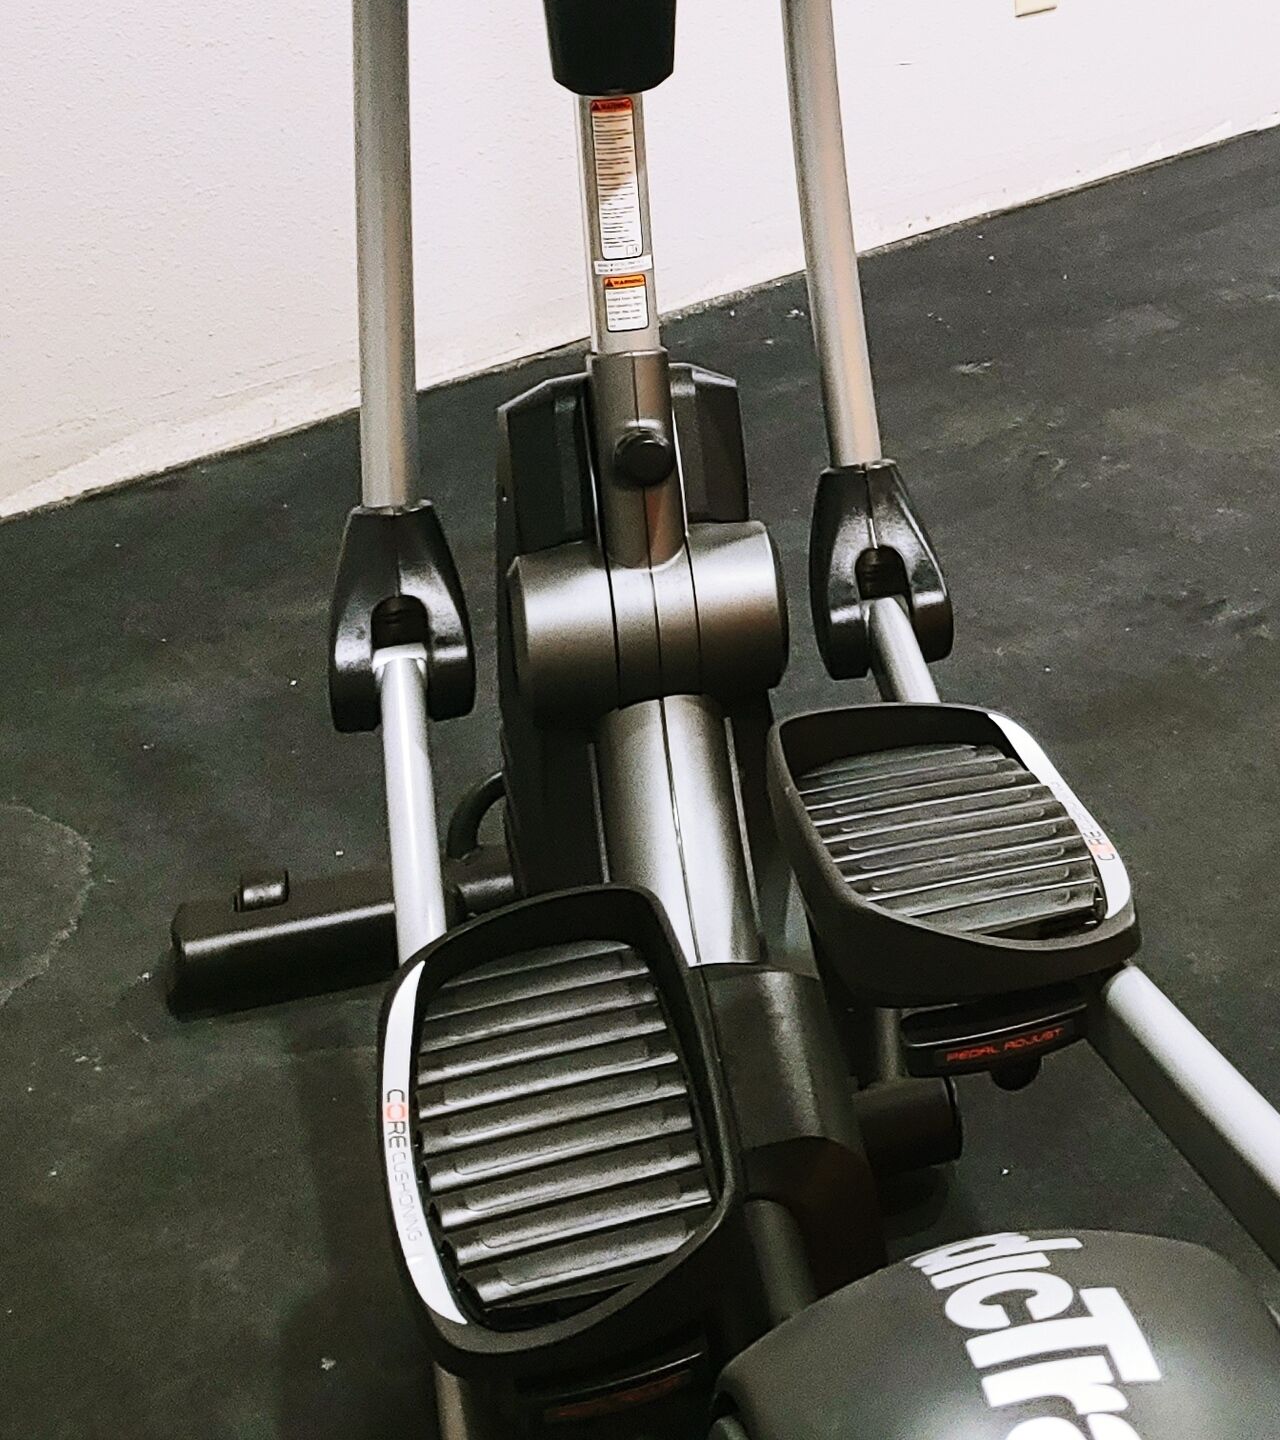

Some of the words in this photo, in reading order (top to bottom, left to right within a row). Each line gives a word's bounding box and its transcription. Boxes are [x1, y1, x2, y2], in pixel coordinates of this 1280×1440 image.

[945, 1045, 1000, 1062] PEDAL
[1003, 1027, 1065, 1051] ADJUST
[386, 1088, 408, 1148] CORE
